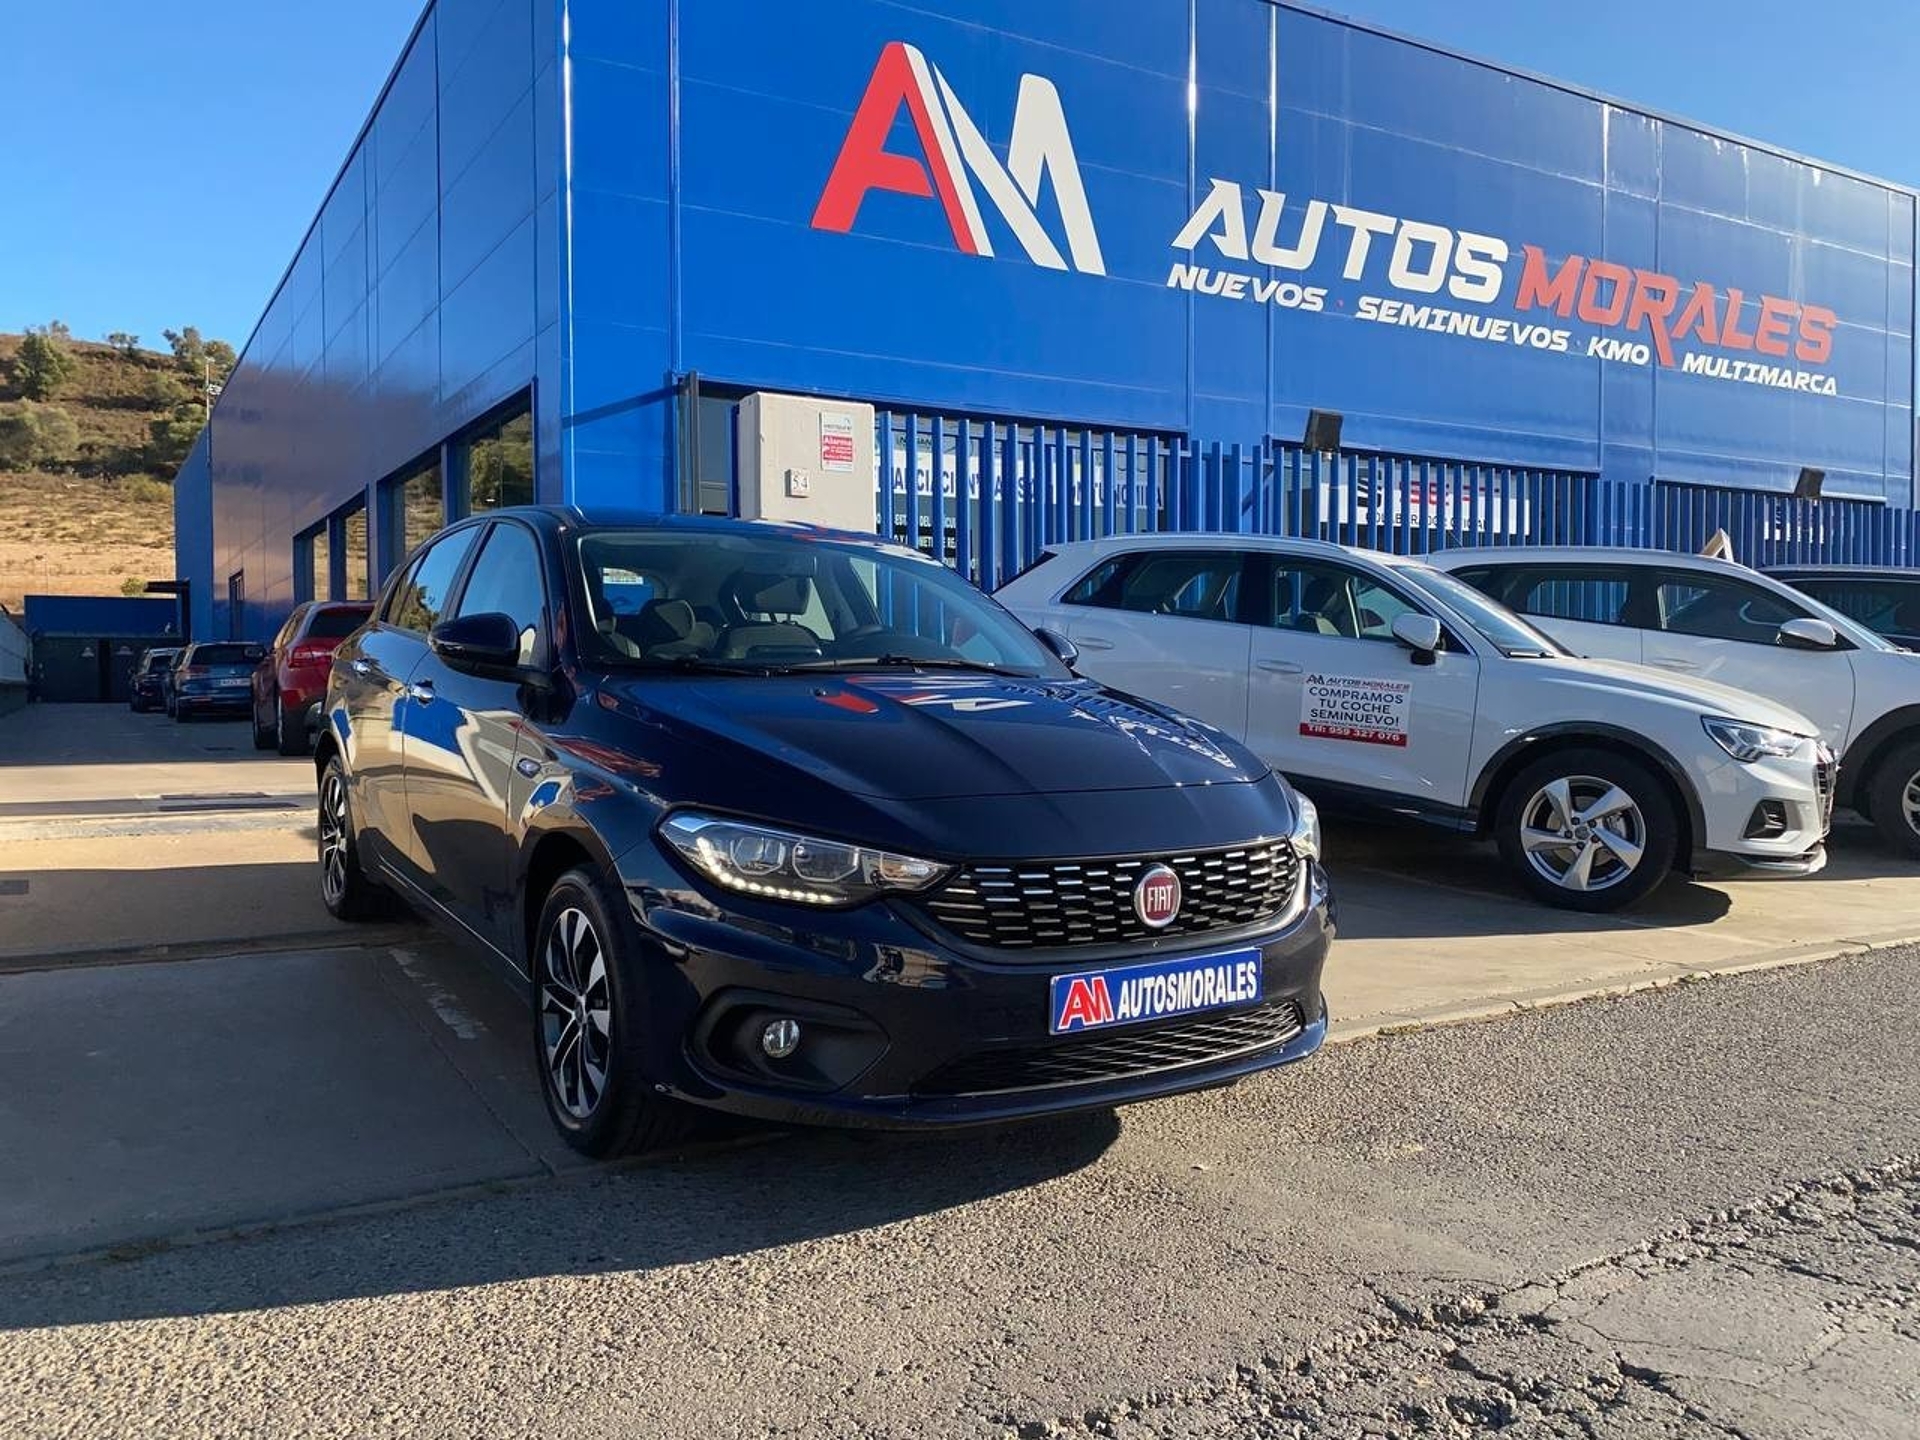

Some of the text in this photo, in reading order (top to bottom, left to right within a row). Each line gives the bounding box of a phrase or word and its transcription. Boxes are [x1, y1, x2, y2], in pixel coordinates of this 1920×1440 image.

[1171, 178, 1838, 367] AUTOS MORALES
[1167, 263, 1328, 312] NUEVOS
[1355, 296, 1570, 352] SEMINUEVOS
[1682, 352, 1837, 396] MULTIMARCA
[1309, 686, 1404, 705] COMPRAMOS
[1320, 699, 1391, 714] TU COCHE
[1310, 708, 1400, 726] SEMINUEVO!
[1147, 884, 1174, 912] FIAT
[1117, 961, 1257, 1020] AUTOSMORALES
